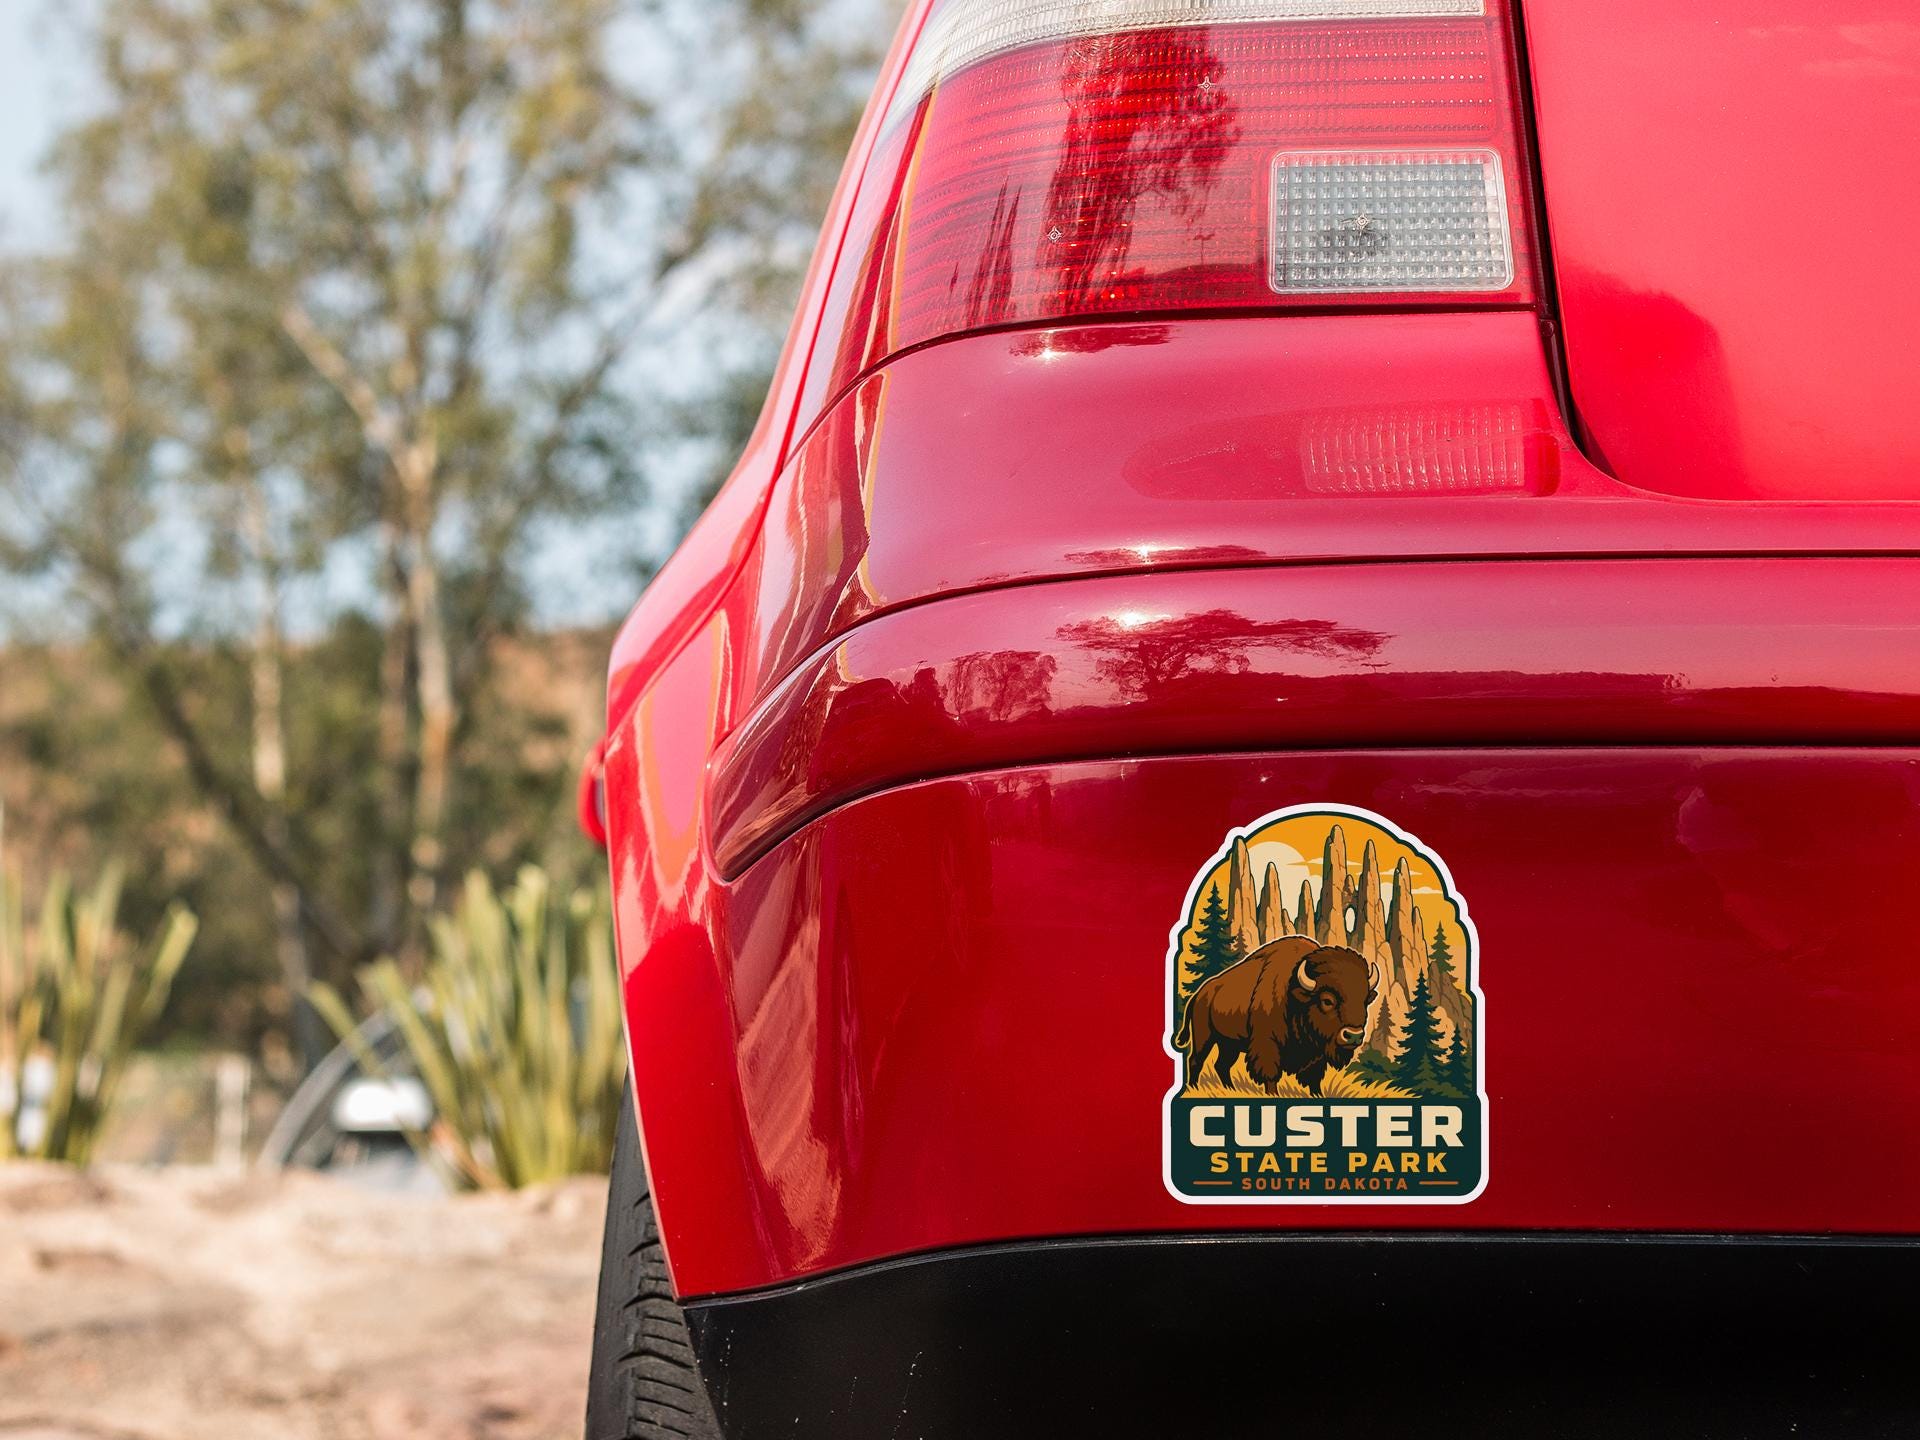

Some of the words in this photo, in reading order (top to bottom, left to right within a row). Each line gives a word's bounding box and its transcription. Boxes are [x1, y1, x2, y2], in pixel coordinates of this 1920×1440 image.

[1189, 1105, 1464, 1147] CUSTER
[1210, 1152, 1328, 1173] STATE
[1348, 1152, 1447, 1173] PARK
[1241, 1177, 1310, 1190] SOUTH
[1325, 1177, 1408, 1190] DAKOTA
